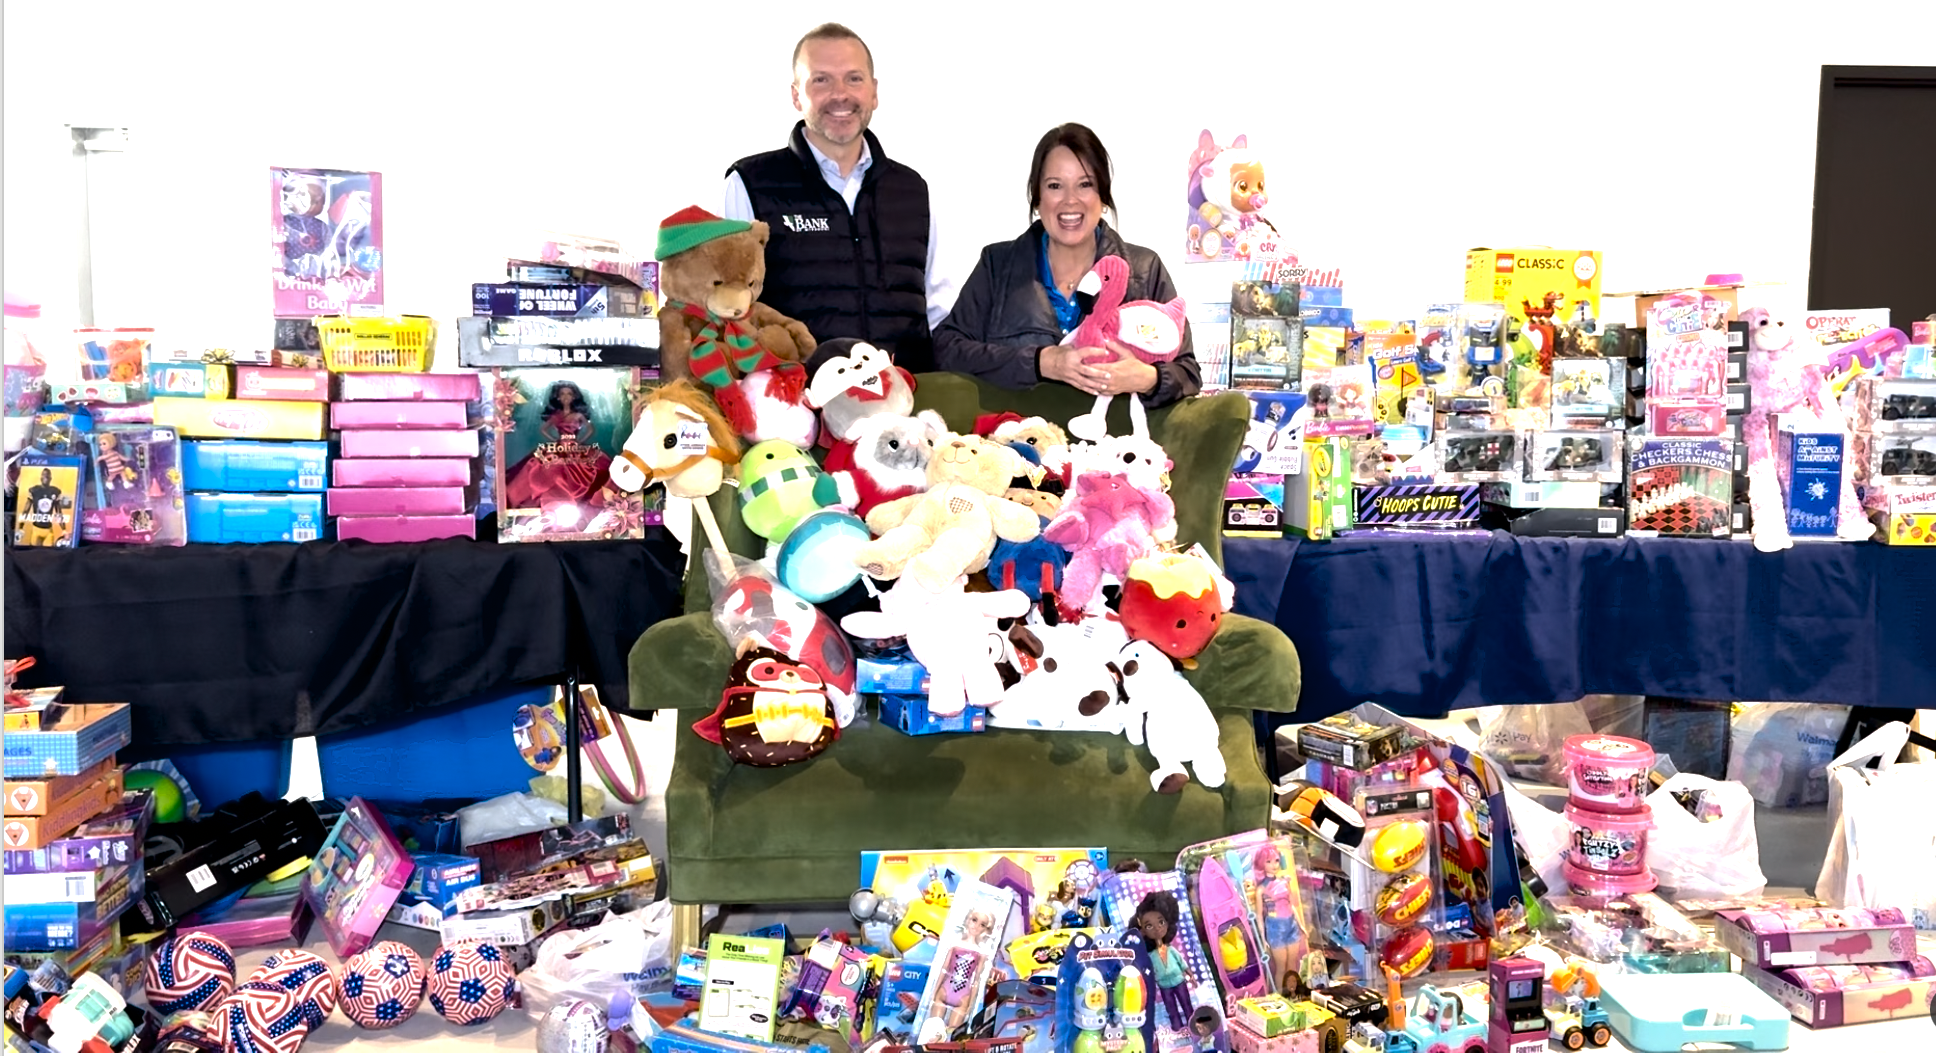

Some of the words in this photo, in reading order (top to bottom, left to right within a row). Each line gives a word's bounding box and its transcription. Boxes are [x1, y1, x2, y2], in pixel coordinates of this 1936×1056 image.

[795, 218, 830, 229] BANK
[1517, 258, 1565, 269] CLASSIC
[277, 277, 321, 291] Drink
[519, 289, 577, 300] FORTUNE
[307, 295, 348, 313] Baby
[538, 300, 577, 310] WHEEL
[1372, 348, 1402, 360] Golf
[1305, 420, 1331, 434] Barbie
[547, 442, 591, 454] Holiday
[1630, 448, 1693, 462] CHECKERS
[1694, 448, 1732, 462] CHESS
[1648, 456, 1726, 468] BACKGAMMON
[1381, 497, 1420, 514] HOOPS
[1422, 495, 1458, 511] CUTIE
[19, 513, 52, 523] MADDEN
[1796, 731, 1838, 747] Walma
[1461, 781, 1478, 796] 16
[460, 874, 476, 884] BUS
[1394, 884, 1431, 920] CHIEF
[623, 965, 669, 982] Walm
[904, 971, 922, 980] CITY
[776, 1034, 797, 1043] STARTS
[1100, 1039, 1128, 1047] MYSTERY
[1516, 1044, 1543, 1053] FORTNITE
